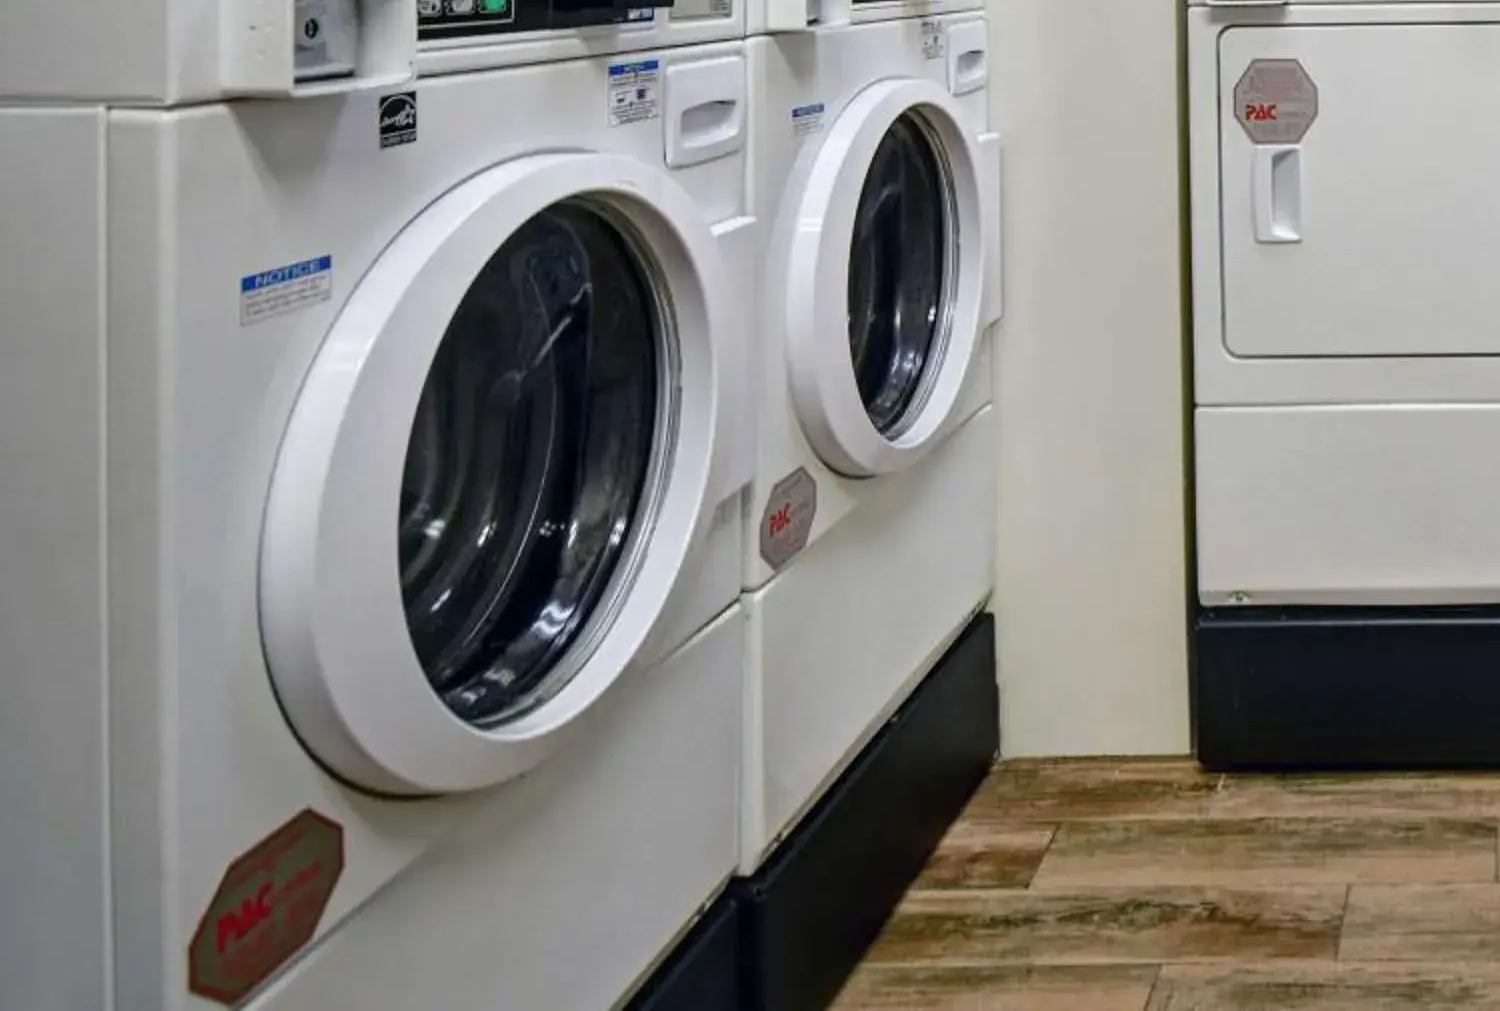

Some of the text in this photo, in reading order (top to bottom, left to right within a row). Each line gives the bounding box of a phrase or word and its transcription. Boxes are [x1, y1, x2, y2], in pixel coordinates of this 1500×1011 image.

[1245, 103, 1277, 121] PAC
[255, 259, 319, 289] NOTICE
[216, 879, 273, 956] PAC
